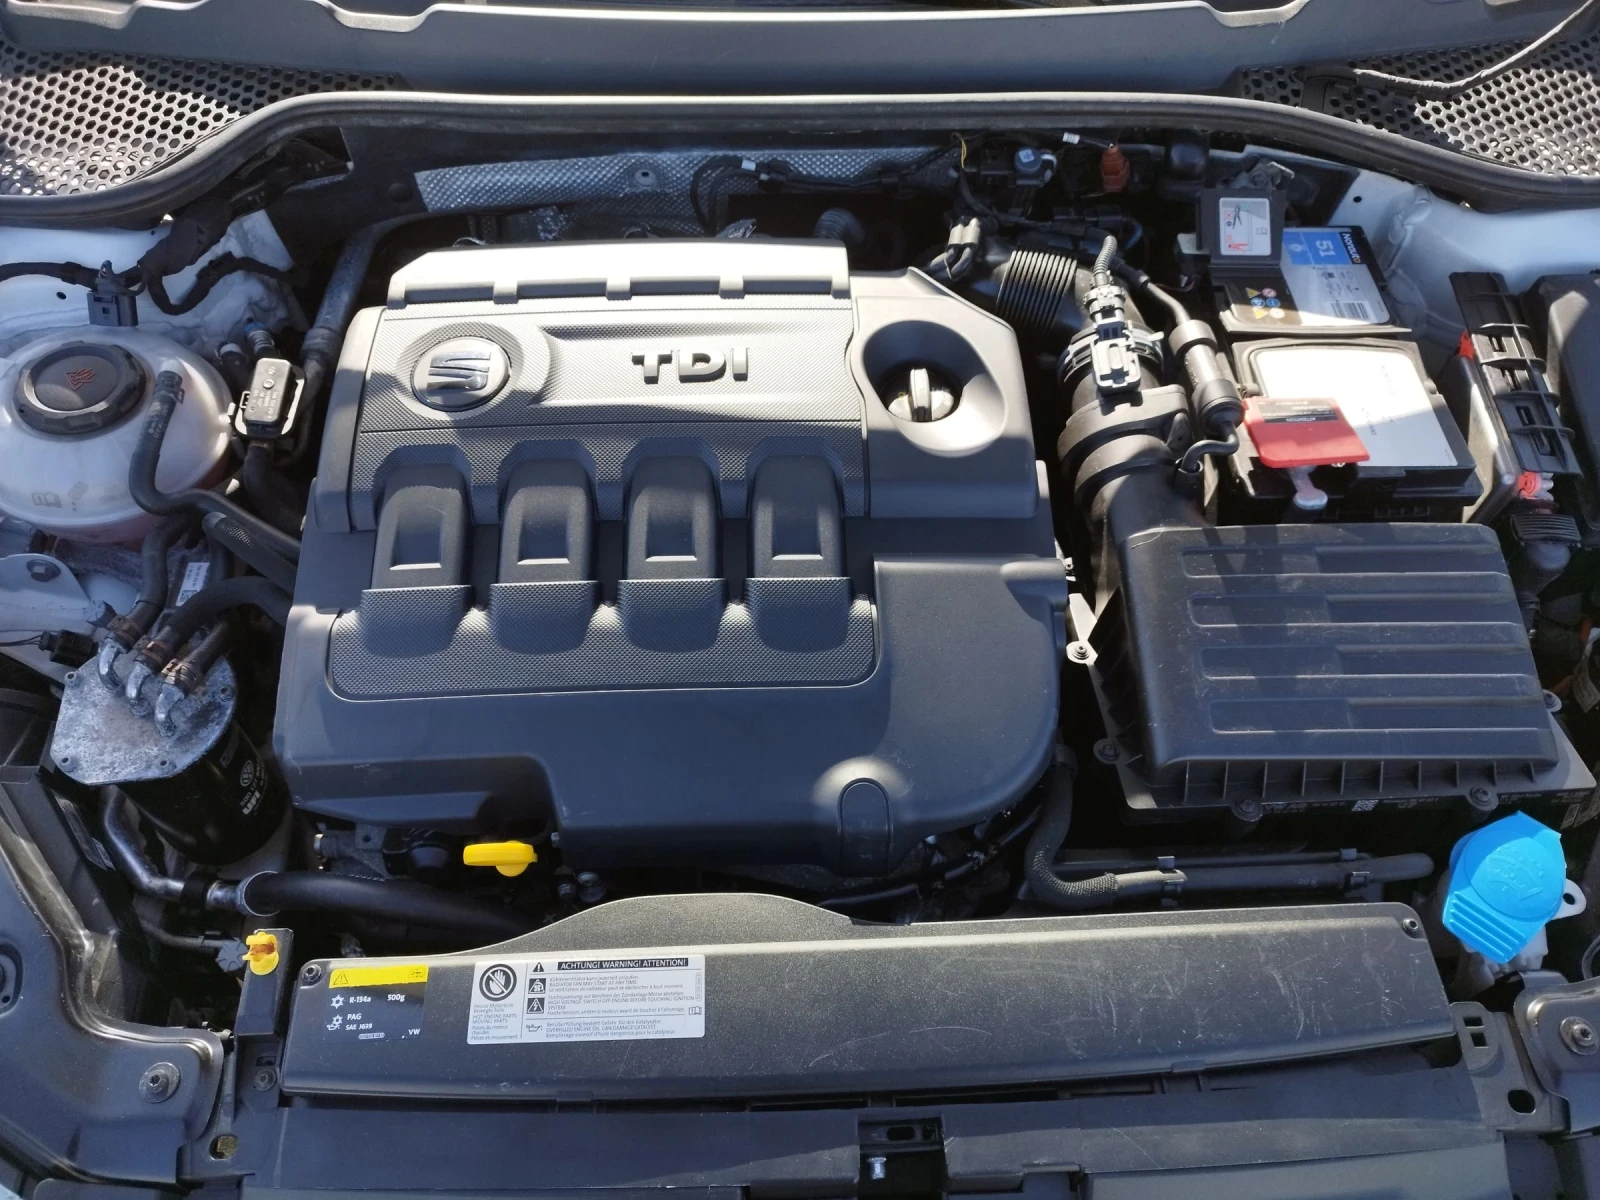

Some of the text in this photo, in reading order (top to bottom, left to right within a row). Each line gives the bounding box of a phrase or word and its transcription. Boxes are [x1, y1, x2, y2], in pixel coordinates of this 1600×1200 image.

[1315, 239, 1336, 257] 51
[630, 347, 749, 385] TDI
[560, 958, 686, 970] ACHTUNG! WARNING! ATTENTION!
[387, 994, 405, 1002] 500g
